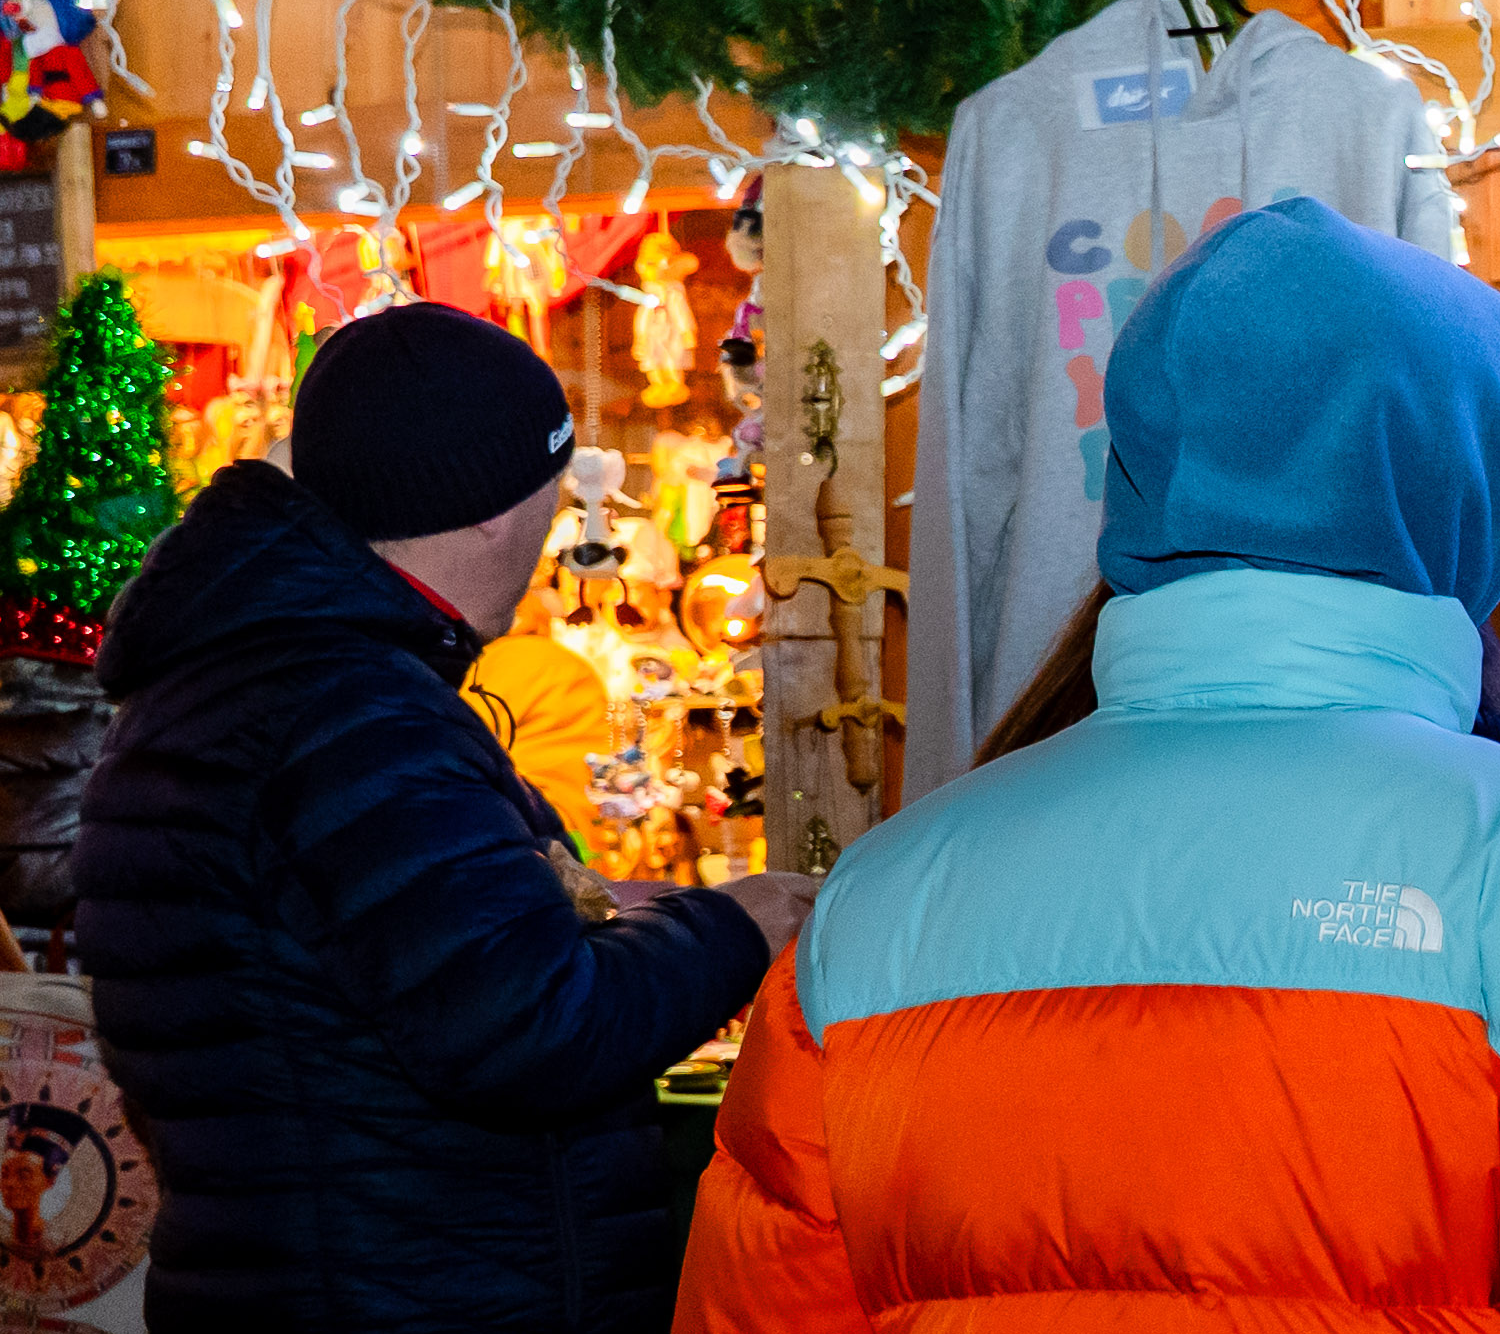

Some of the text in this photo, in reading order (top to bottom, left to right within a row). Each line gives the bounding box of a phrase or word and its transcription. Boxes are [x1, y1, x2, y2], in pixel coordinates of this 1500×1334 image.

[1343, 880, 1400, 905] THE
[1292, 898, 1397, 927] NORTH
[1318, 922, 1393, 949] FACE
